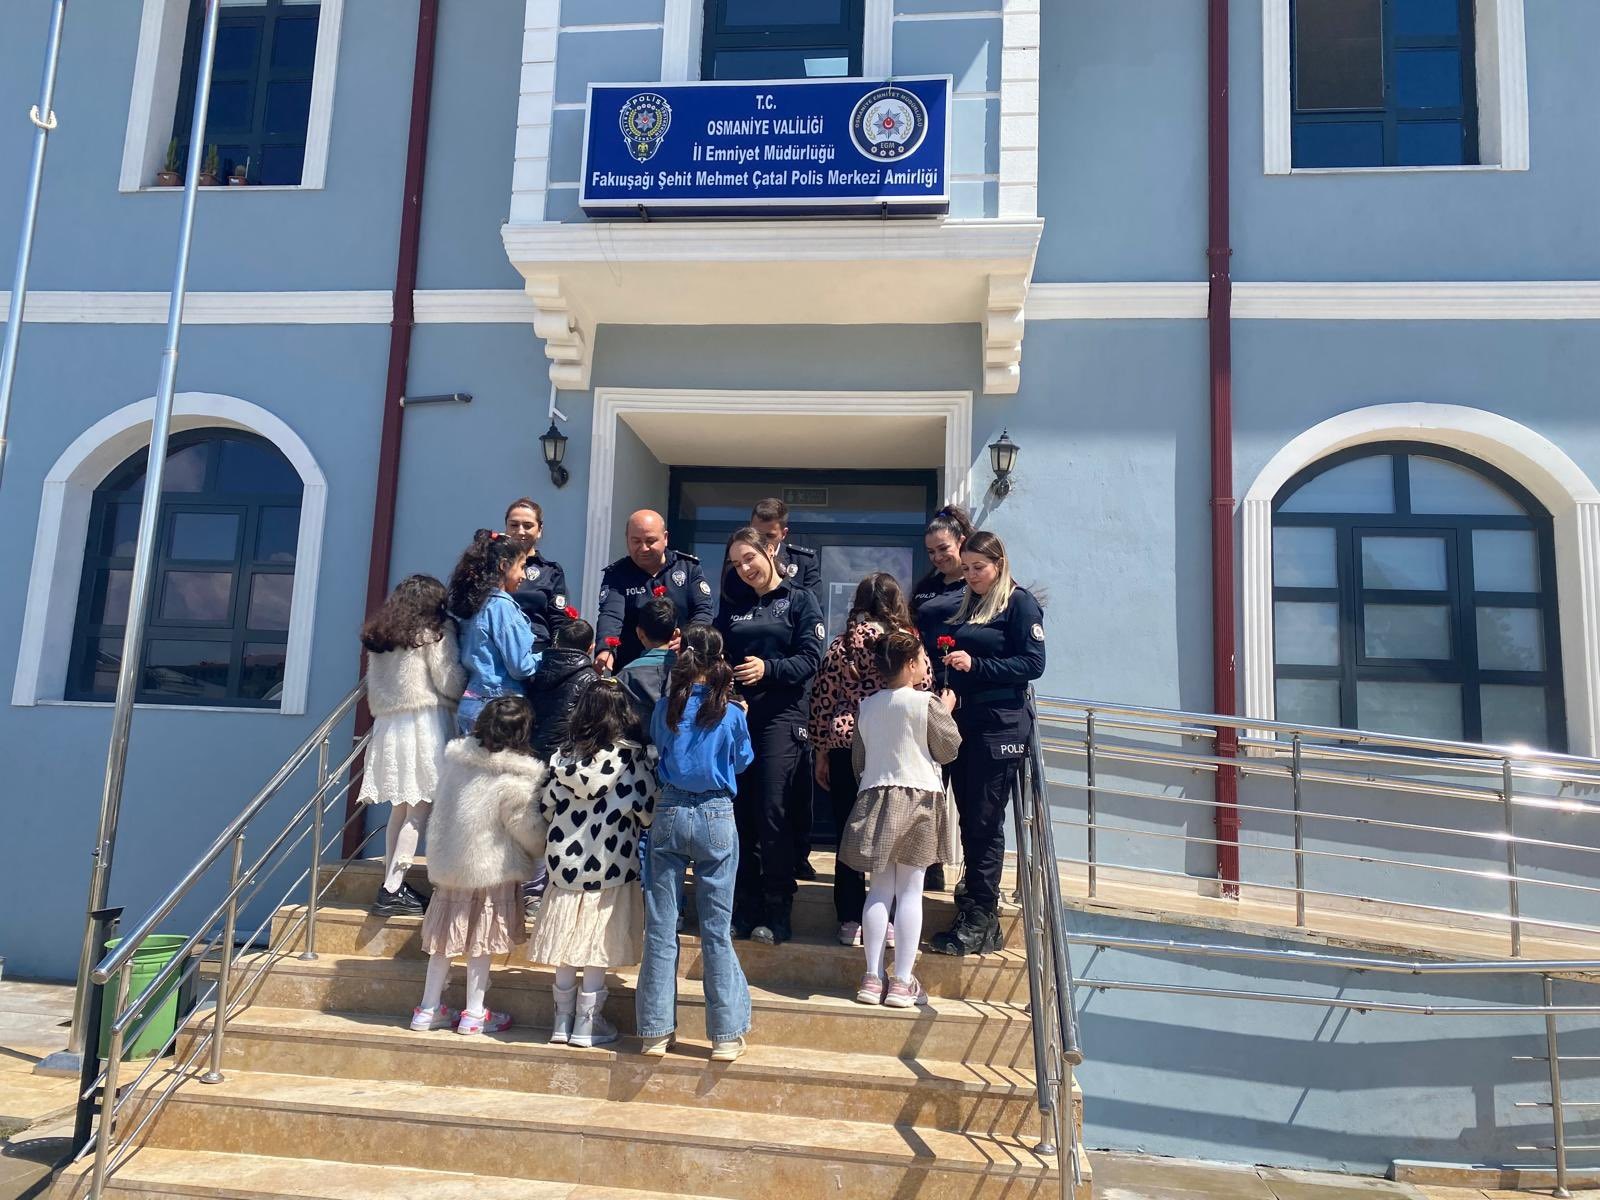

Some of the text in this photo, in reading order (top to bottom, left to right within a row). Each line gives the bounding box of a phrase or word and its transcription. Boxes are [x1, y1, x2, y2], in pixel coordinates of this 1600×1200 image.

[755, 94, 777, 110] T.C.
[707, 115, 824, 136] OSMANİYE VALİLİĞİ
[692, 142, 835, 165] İl Emniyet Müdürlüğü
[592, 168, 938, 190] Fakıuşağı Şehit Mehmet Çatal Polis Merkezi Amirliği
